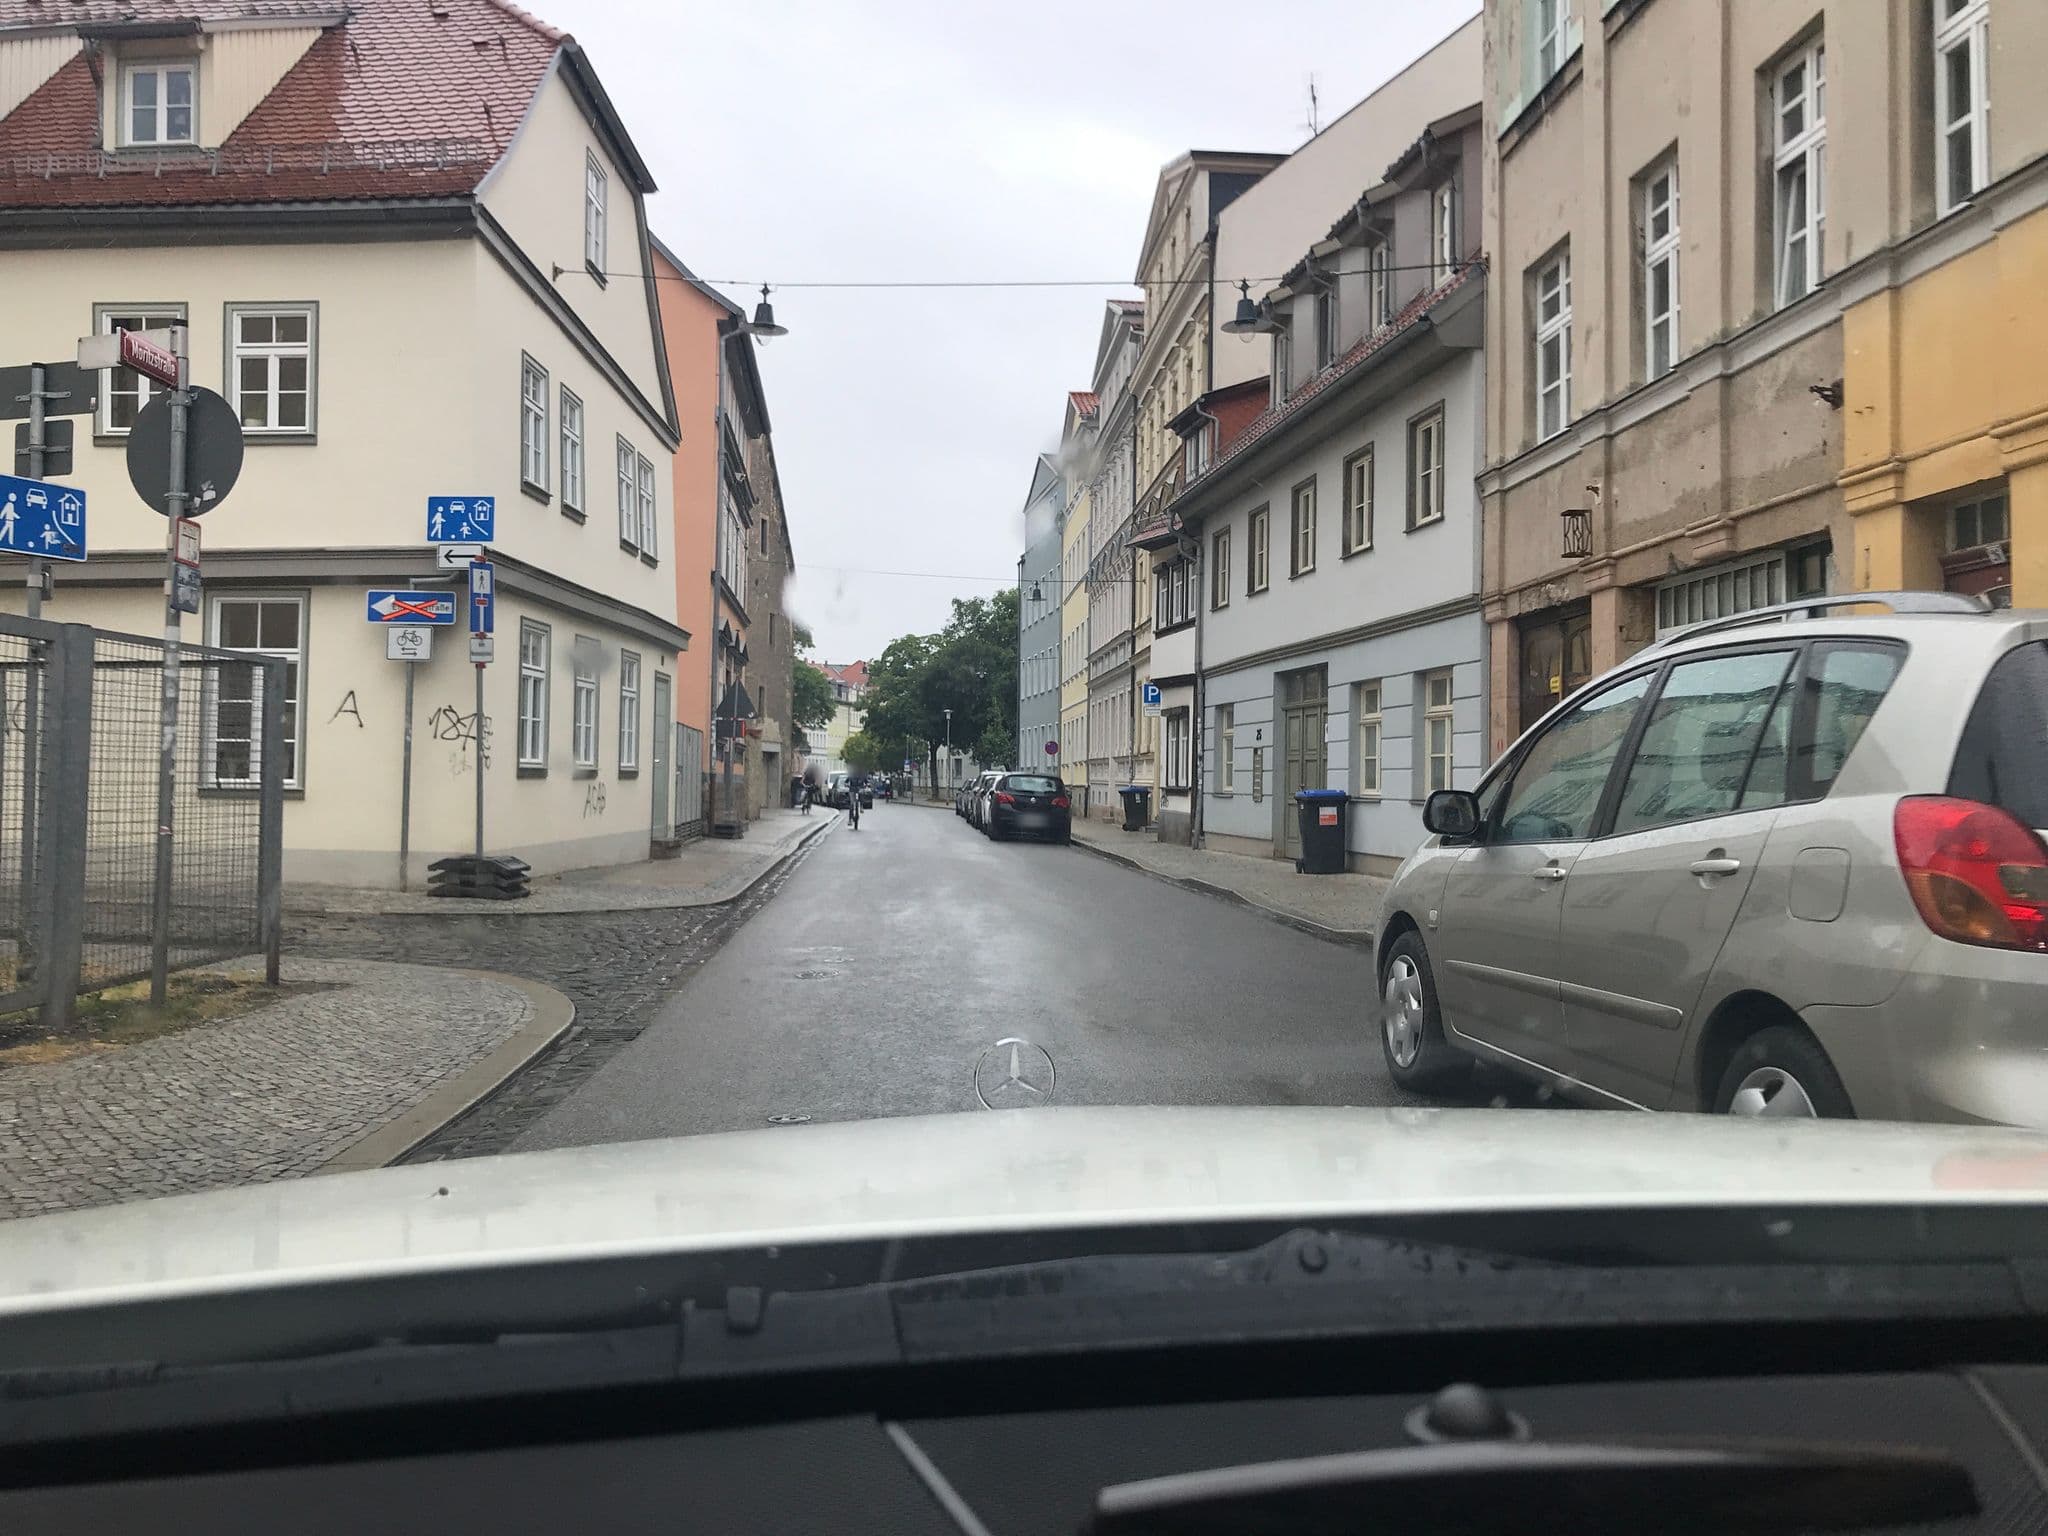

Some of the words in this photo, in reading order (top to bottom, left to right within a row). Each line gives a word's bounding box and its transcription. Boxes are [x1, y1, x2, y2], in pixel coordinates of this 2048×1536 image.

[131, 339, 176, 376] Moritzstraße
[328, 689, 363, 728] A
[1148, 686, 1159, 702] P
